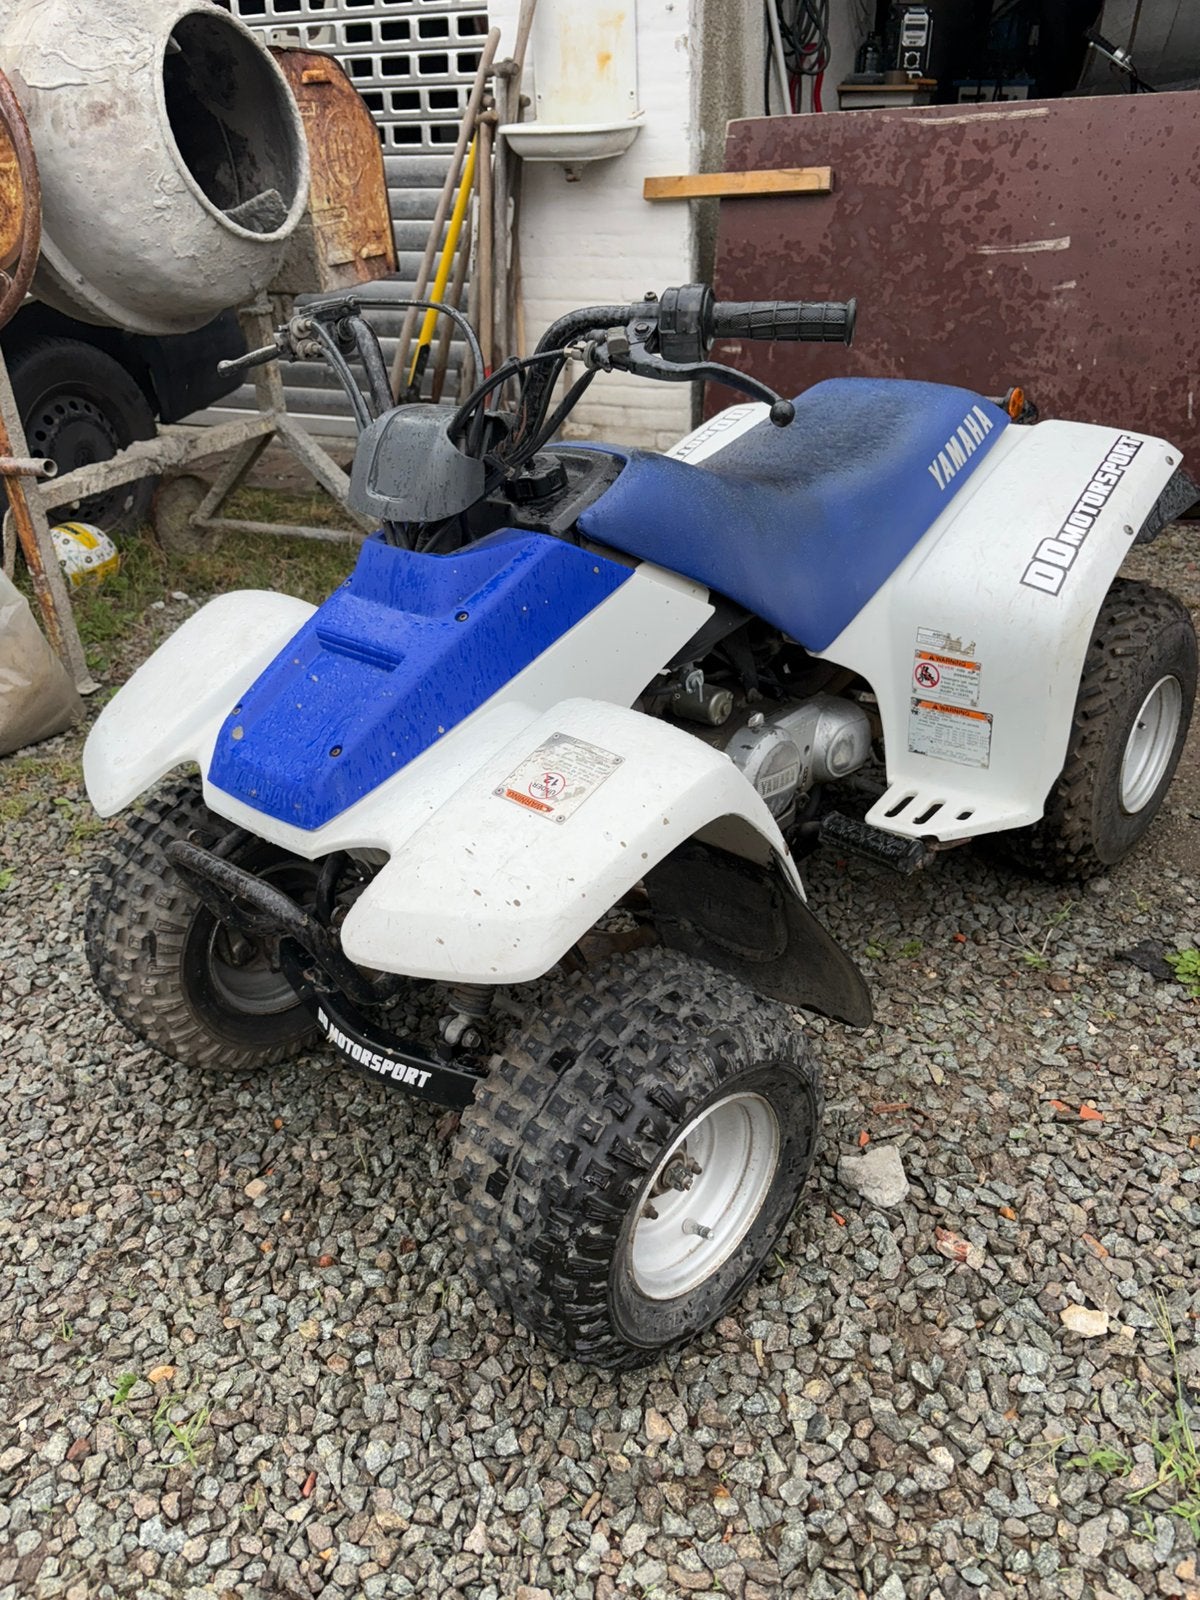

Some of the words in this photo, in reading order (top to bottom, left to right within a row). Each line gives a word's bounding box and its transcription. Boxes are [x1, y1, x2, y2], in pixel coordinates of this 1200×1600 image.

[928, 405, 994, 491] YAMAHA
[936, 656, 966, 668] WARNING
[940, 704, 970, 716] WARNING
[543, 775, 559, 787] 12
[507, 790, 544, 811] WARNING
[328, 1022, 433, 1088] MOTORSPORT
